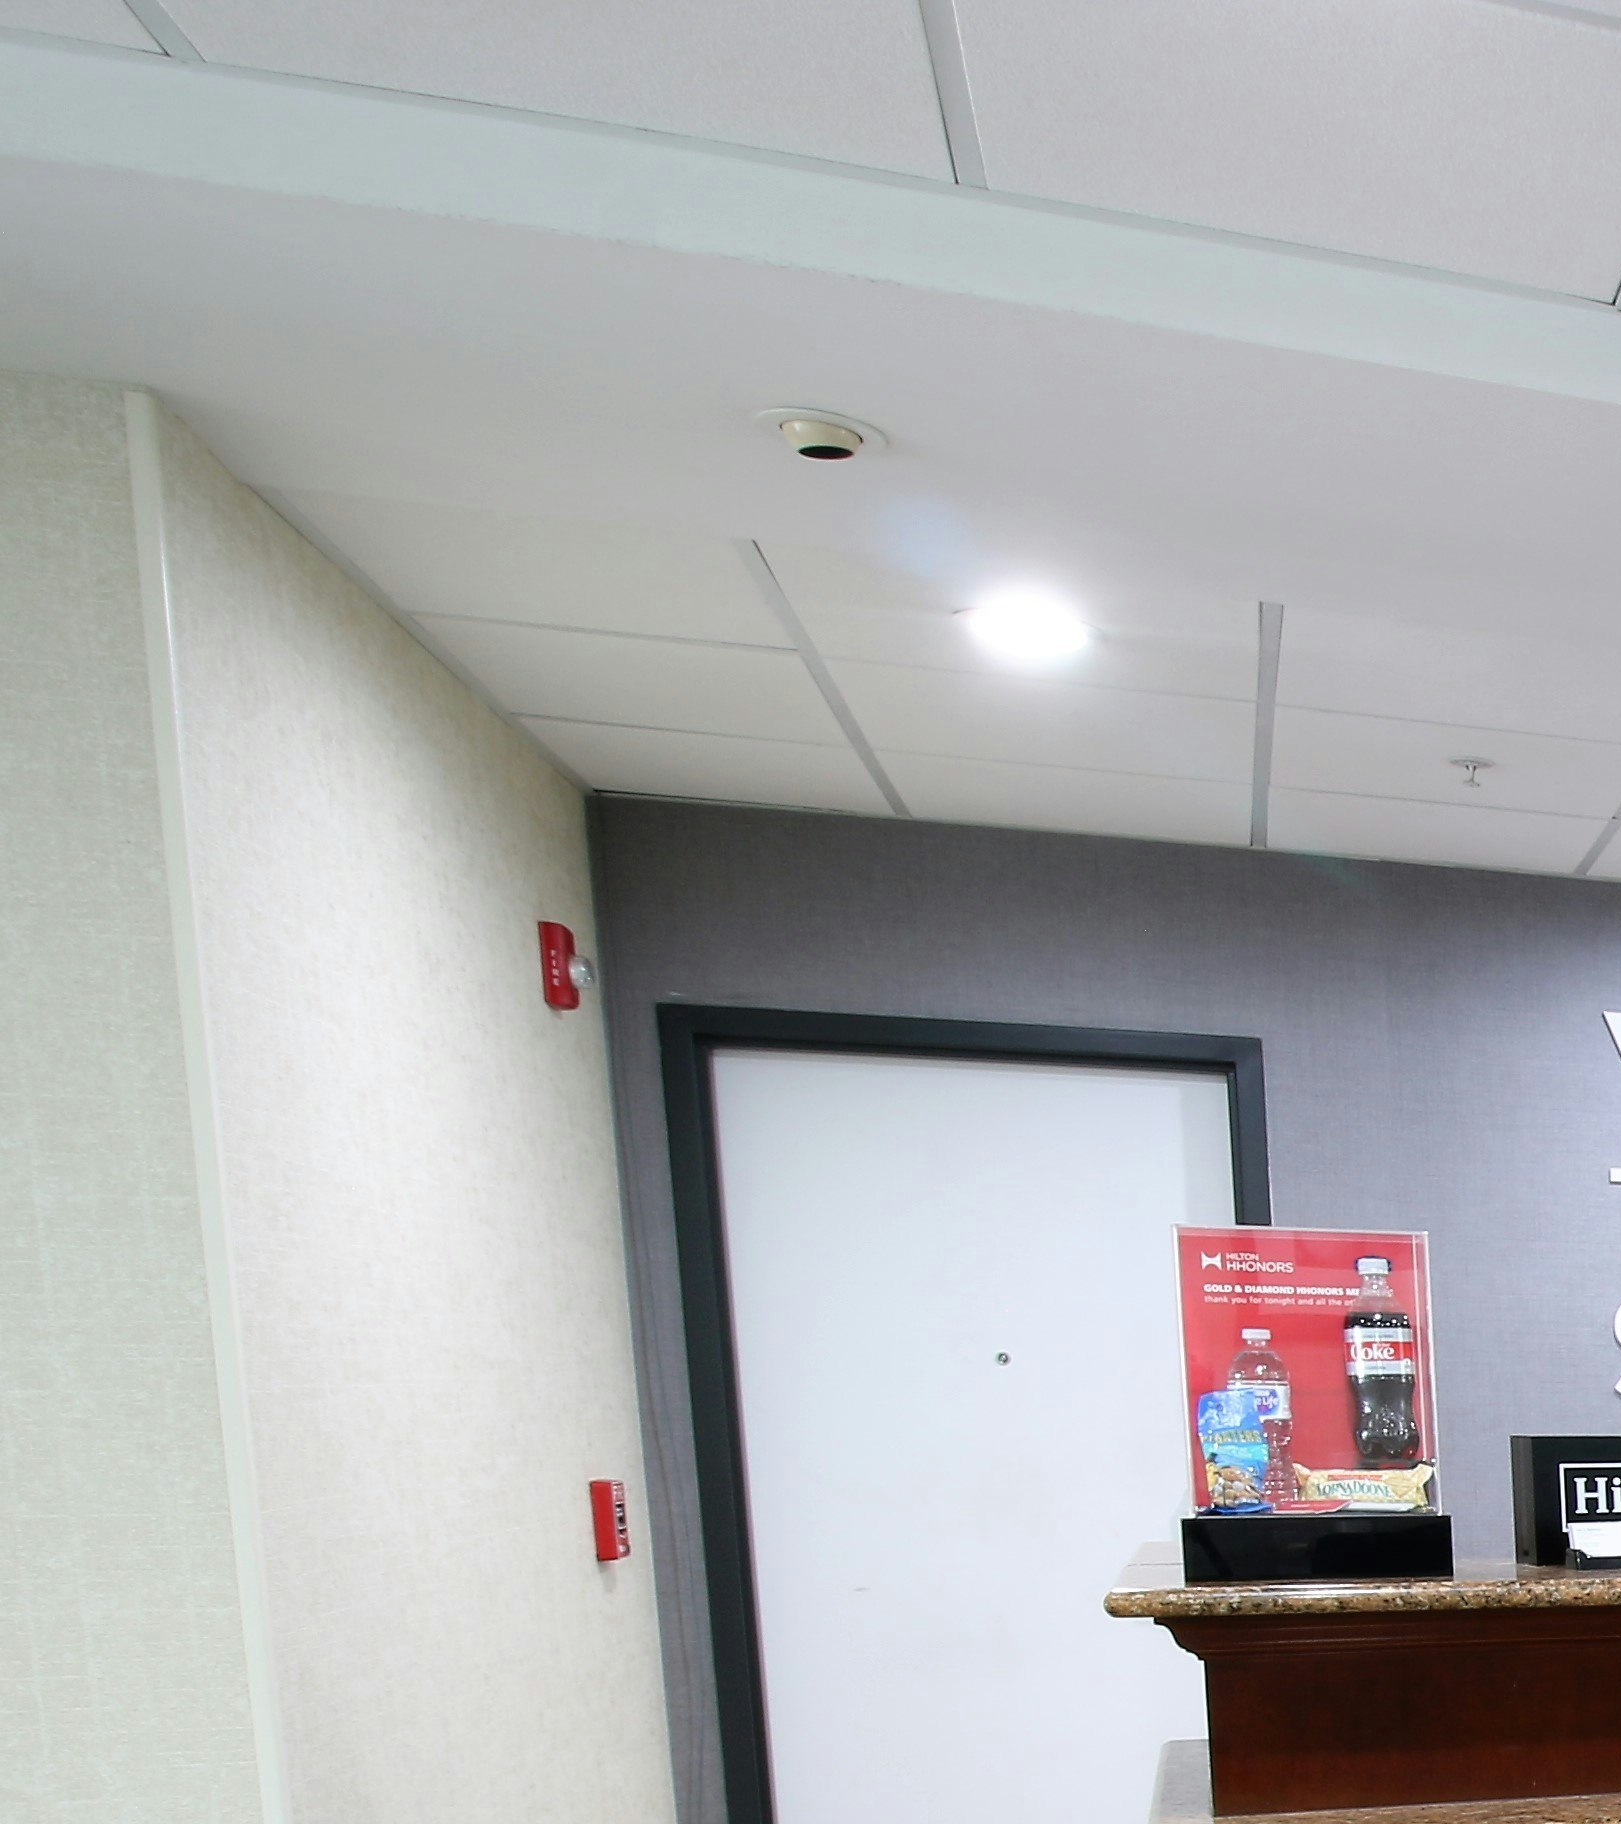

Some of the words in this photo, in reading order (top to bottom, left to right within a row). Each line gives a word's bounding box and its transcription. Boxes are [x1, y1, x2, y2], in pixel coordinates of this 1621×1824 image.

[1226, 1252, 1259, 1261] HILTON
[1226, 1261, 1294, 1273] HHONORS
[1203, 1283, 1233, 1292] GOLD
[1244, 1285, 1294, 1294] DIAMOND
[1231, 1297, 1247, 1305] you
[1264, 1297, 1295, 1306] tonight
[1350, 1343, 1395, 1360] Coke
